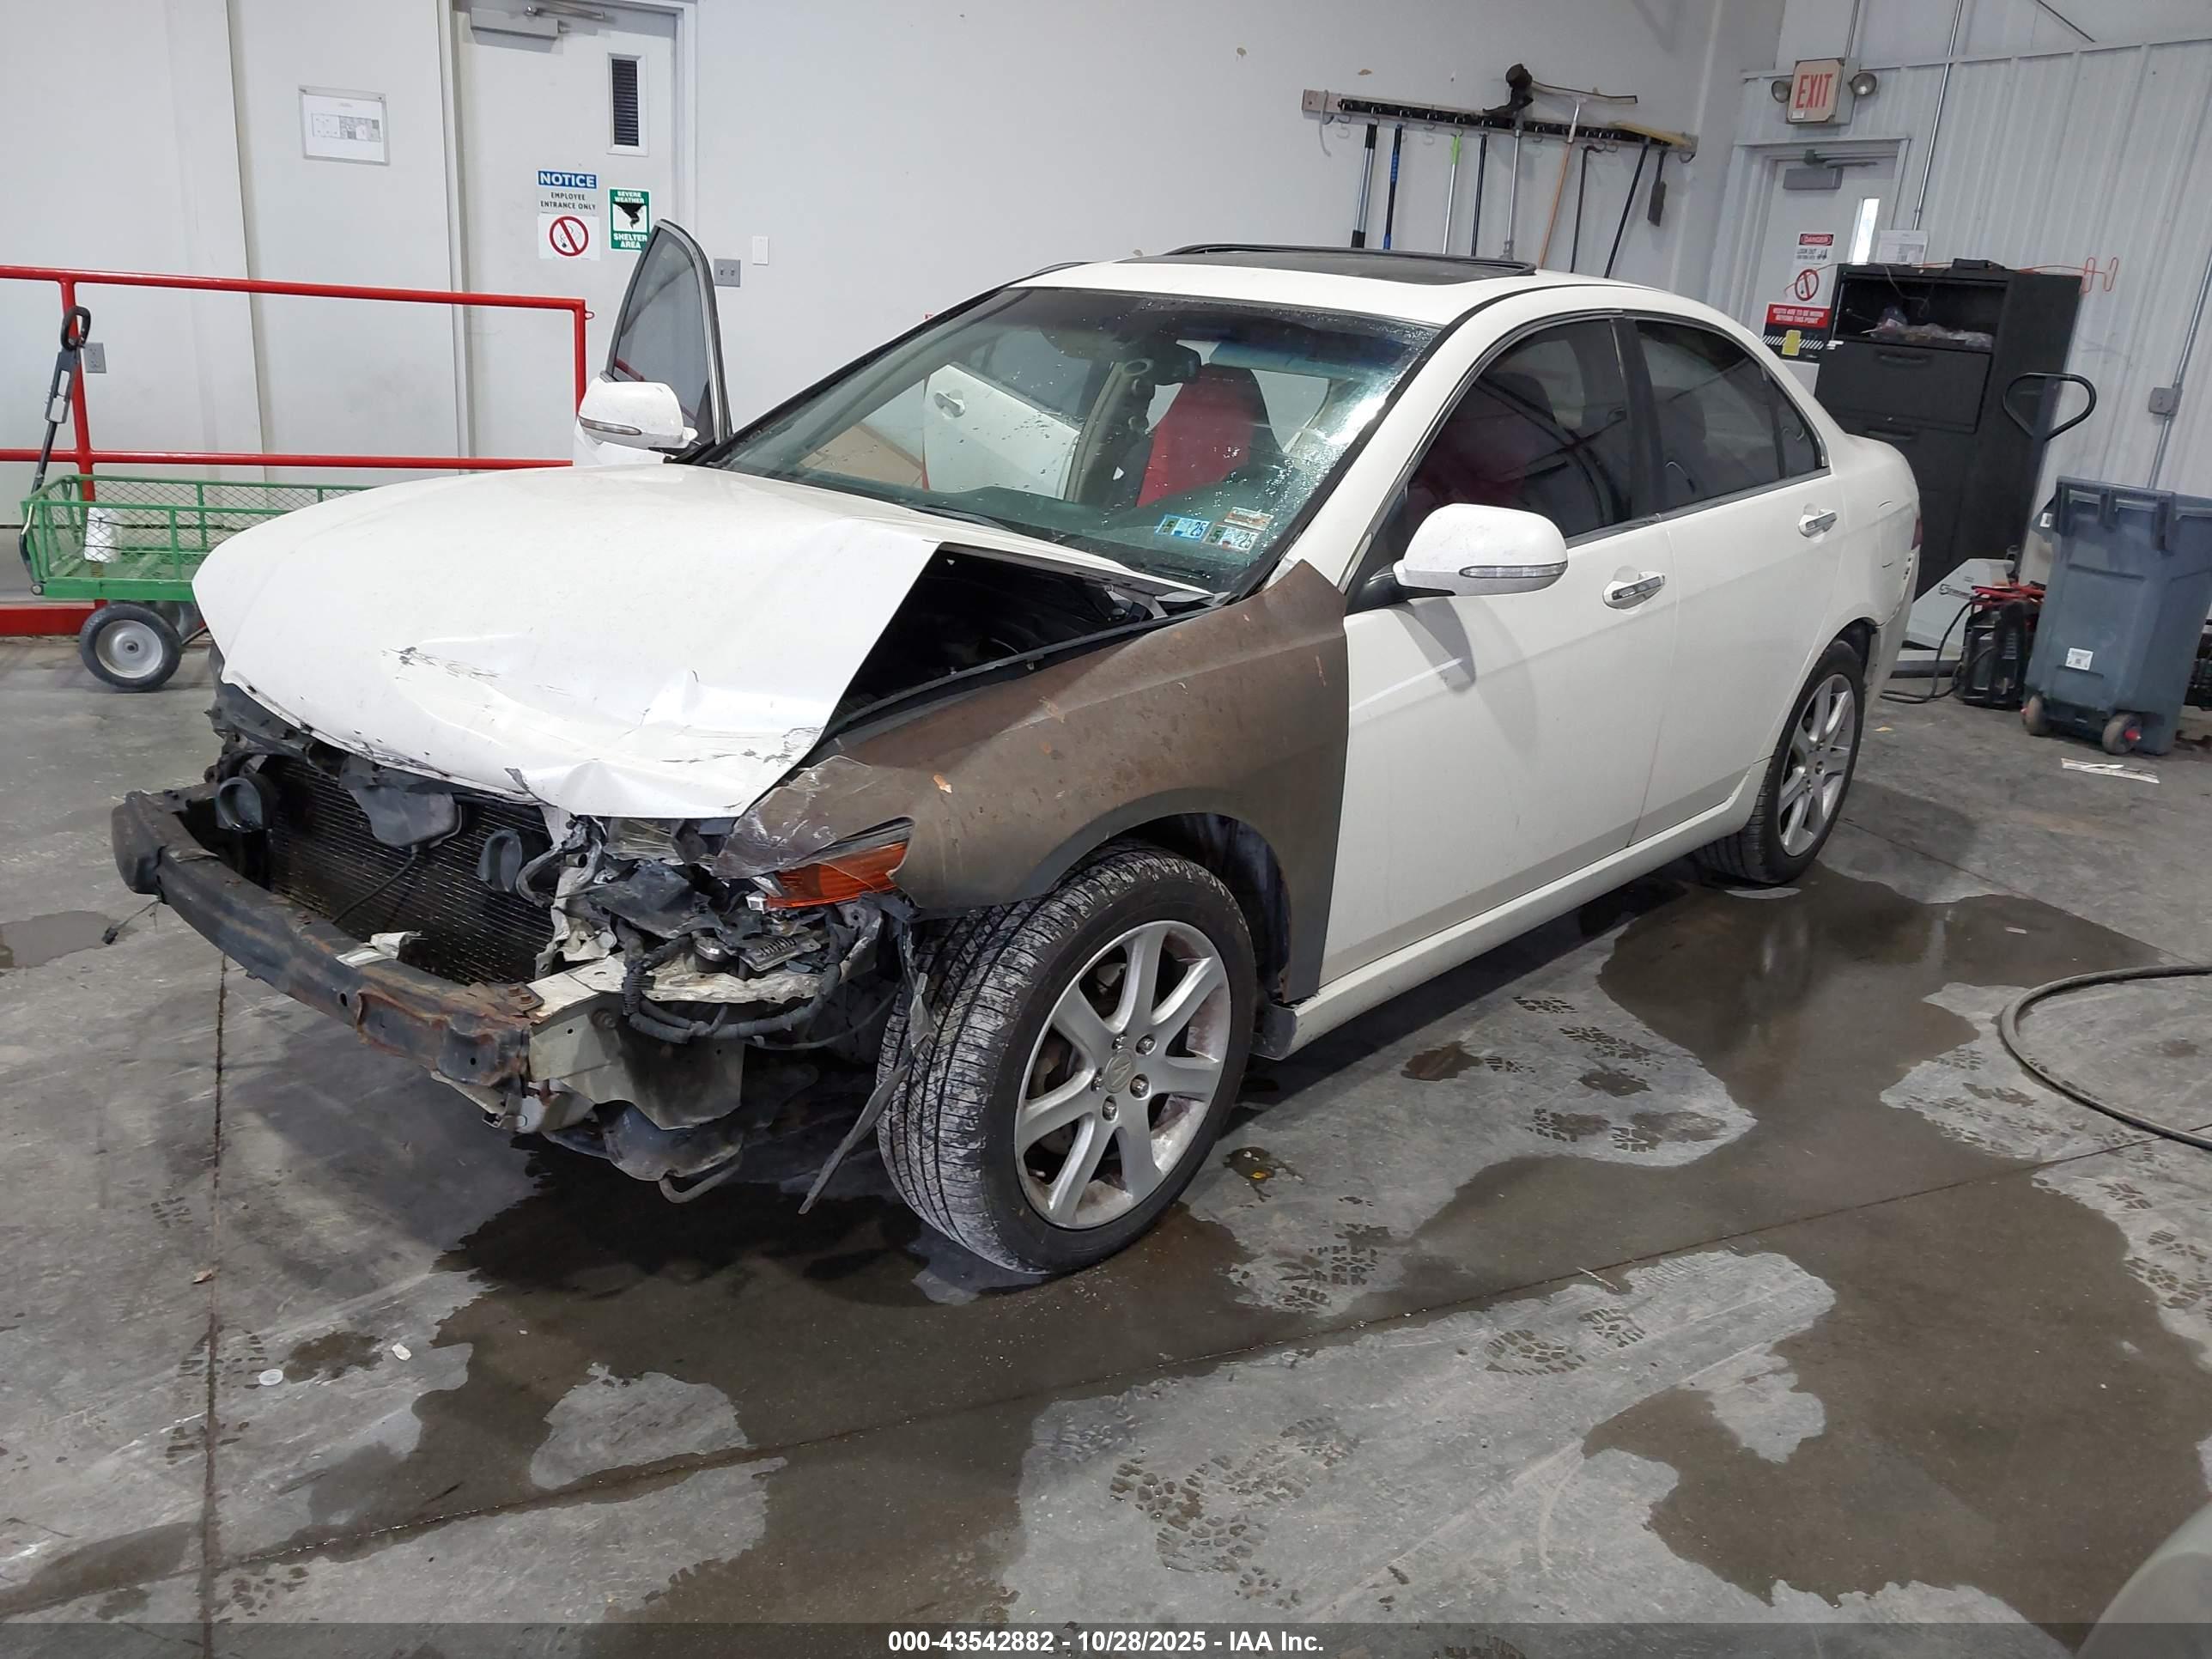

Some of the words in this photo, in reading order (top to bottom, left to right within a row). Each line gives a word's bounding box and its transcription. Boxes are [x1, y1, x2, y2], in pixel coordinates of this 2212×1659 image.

[1795, 73, 1833, 109] EXIT
[540, 173, 595, 187] NOTICE
[550, 191, 586, 201] EMPLOYEE
[614, 196, 645, 204] WEATHER
[540, 201, 576, 210] ENTRANCE
[613, 233, 648, 242] SHELTER
[620, 240, 642, 249] AREA
[1190, 521, 1207, 537] 25
[1238, 532, 1255, 549] 25
